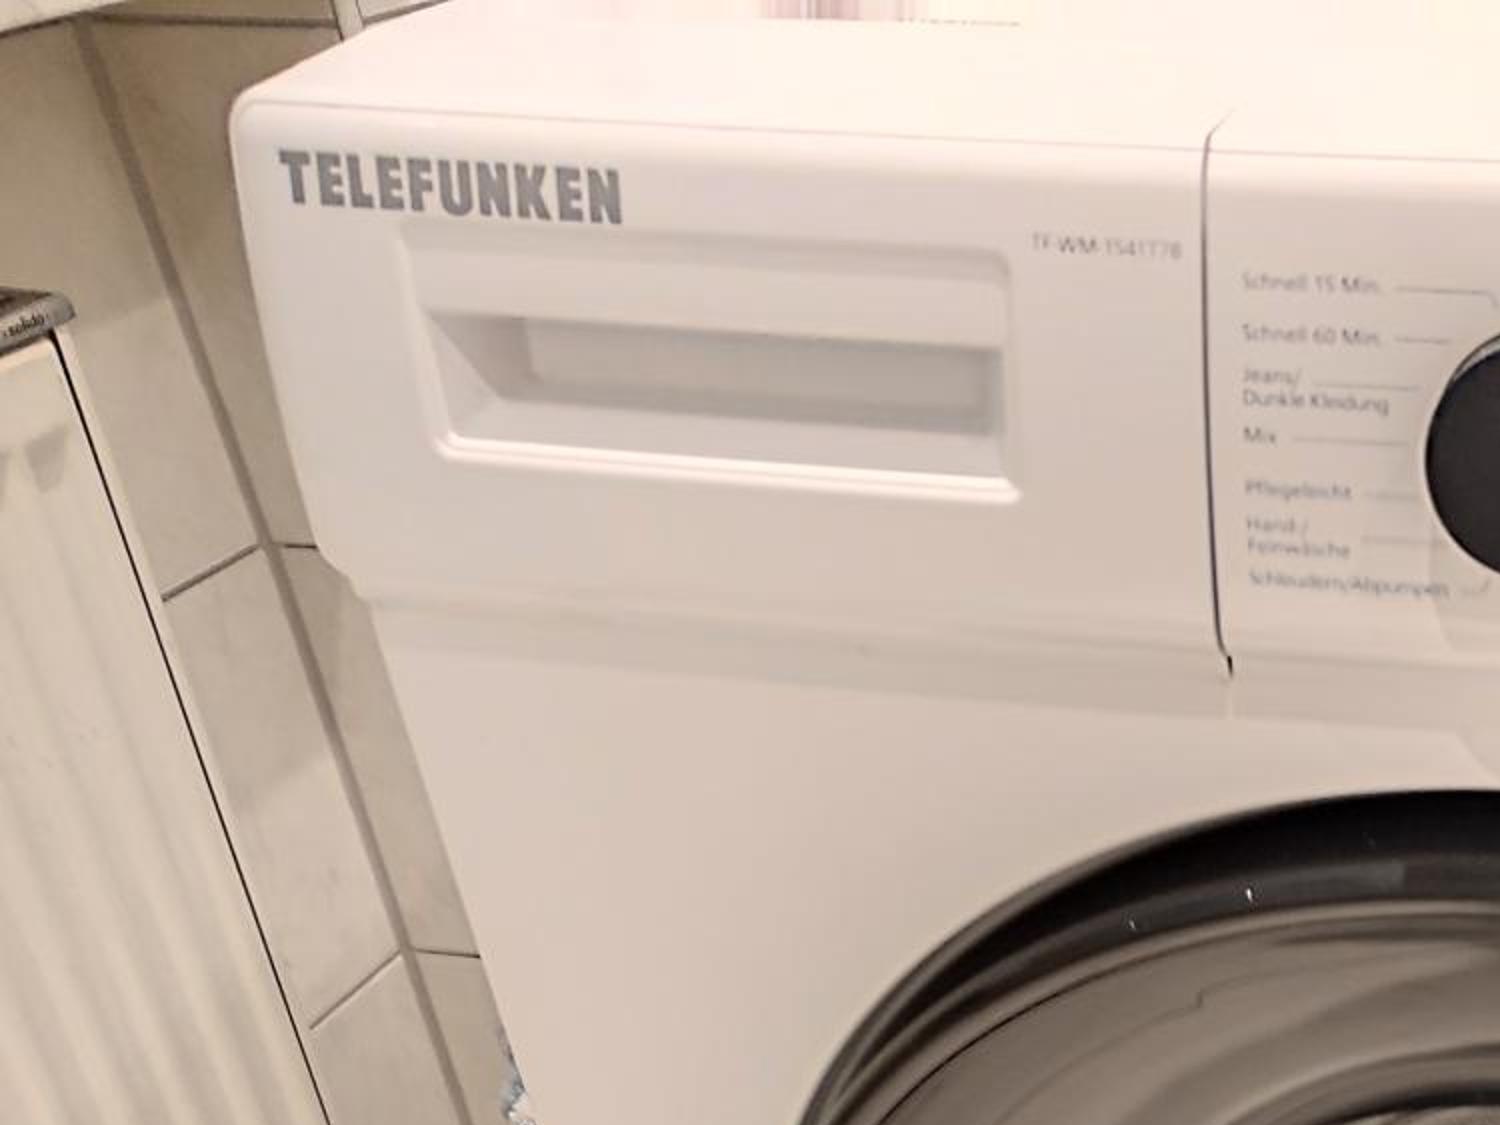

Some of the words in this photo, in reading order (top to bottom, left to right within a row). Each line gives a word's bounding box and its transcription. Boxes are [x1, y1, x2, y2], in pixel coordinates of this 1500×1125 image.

[279, 150, 623, 225] TELEFUNKEN
[1241, 272, 1308, 293] Schnell
[1315, 275, 1335, 293] 15
[1241, 323, 1308, 344] Schnell
[1312, 325, 1336, 345] 60
[1243, 389, 1306, 410] Dunkle
[1310, 393, 1390, 418] Kleidung
[1243, 425, 1278, 445] Mix
[1245, 478, 1353, 503] Pflegeleicht
